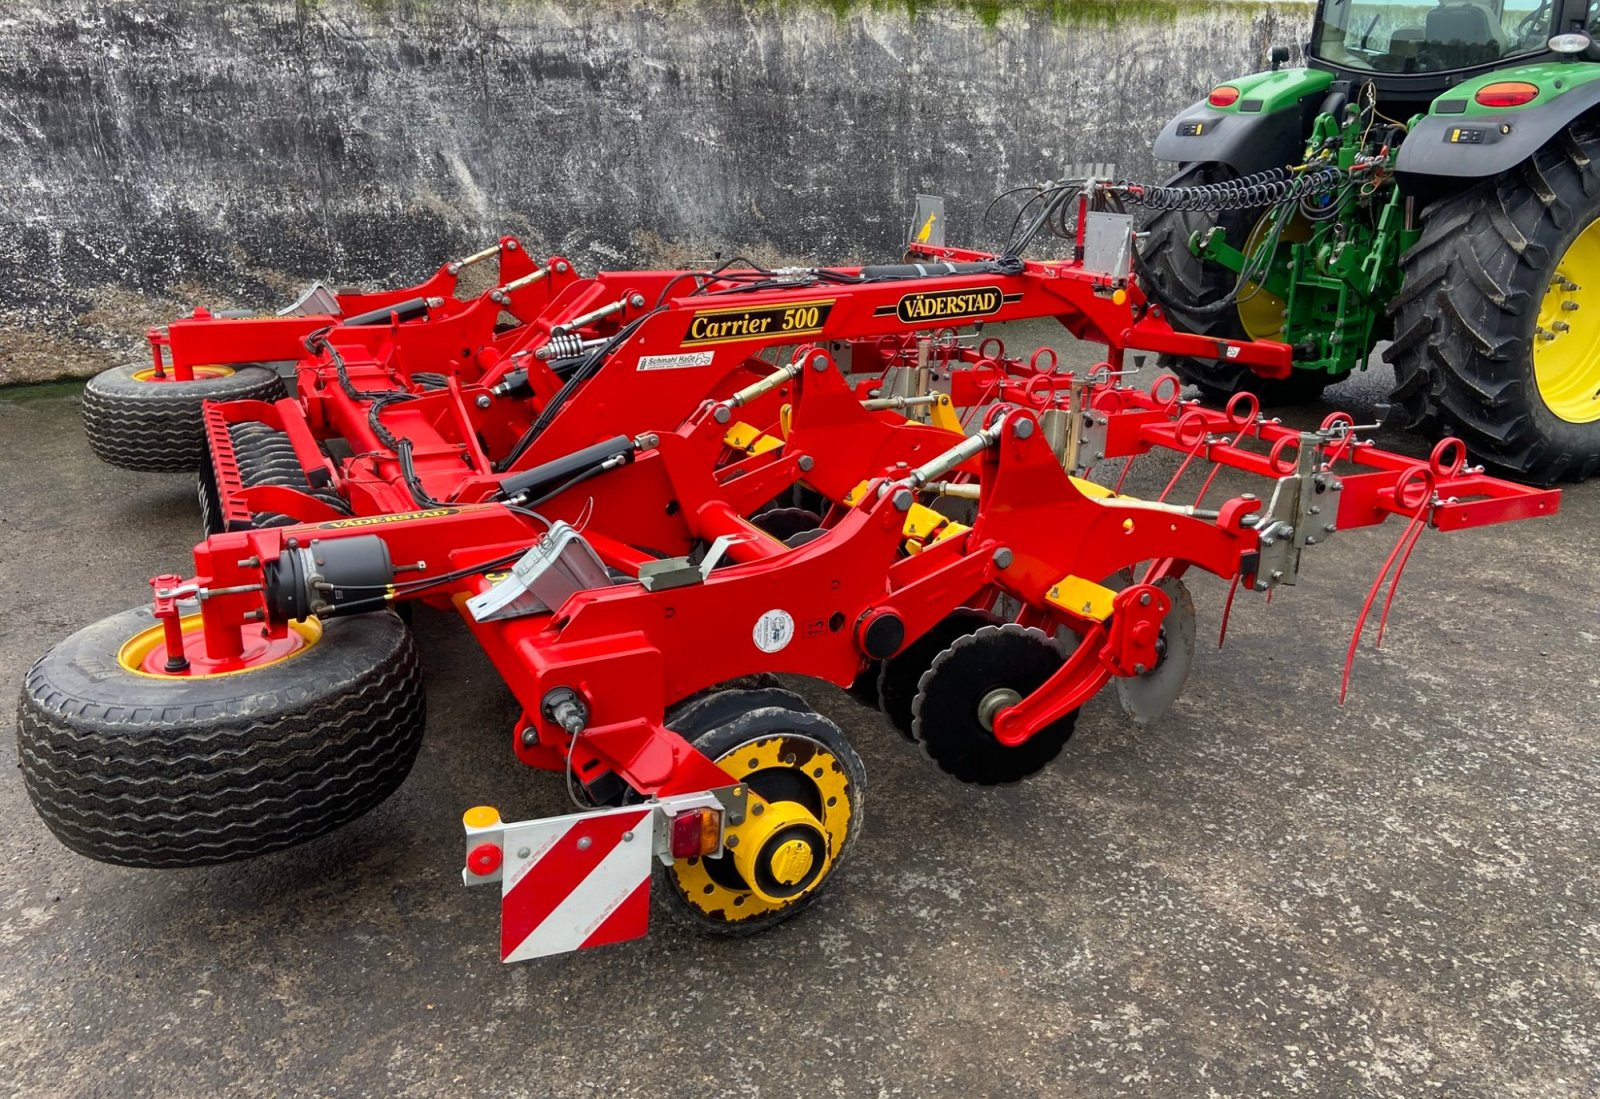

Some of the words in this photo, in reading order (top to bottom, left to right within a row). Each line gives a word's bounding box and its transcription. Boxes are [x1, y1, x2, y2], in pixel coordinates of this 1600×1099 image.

[904, 292, 996, 318] VÄDERSTAD
[691, 313, 772, 339] Carrier
[781, 307, 819, 330] 500
